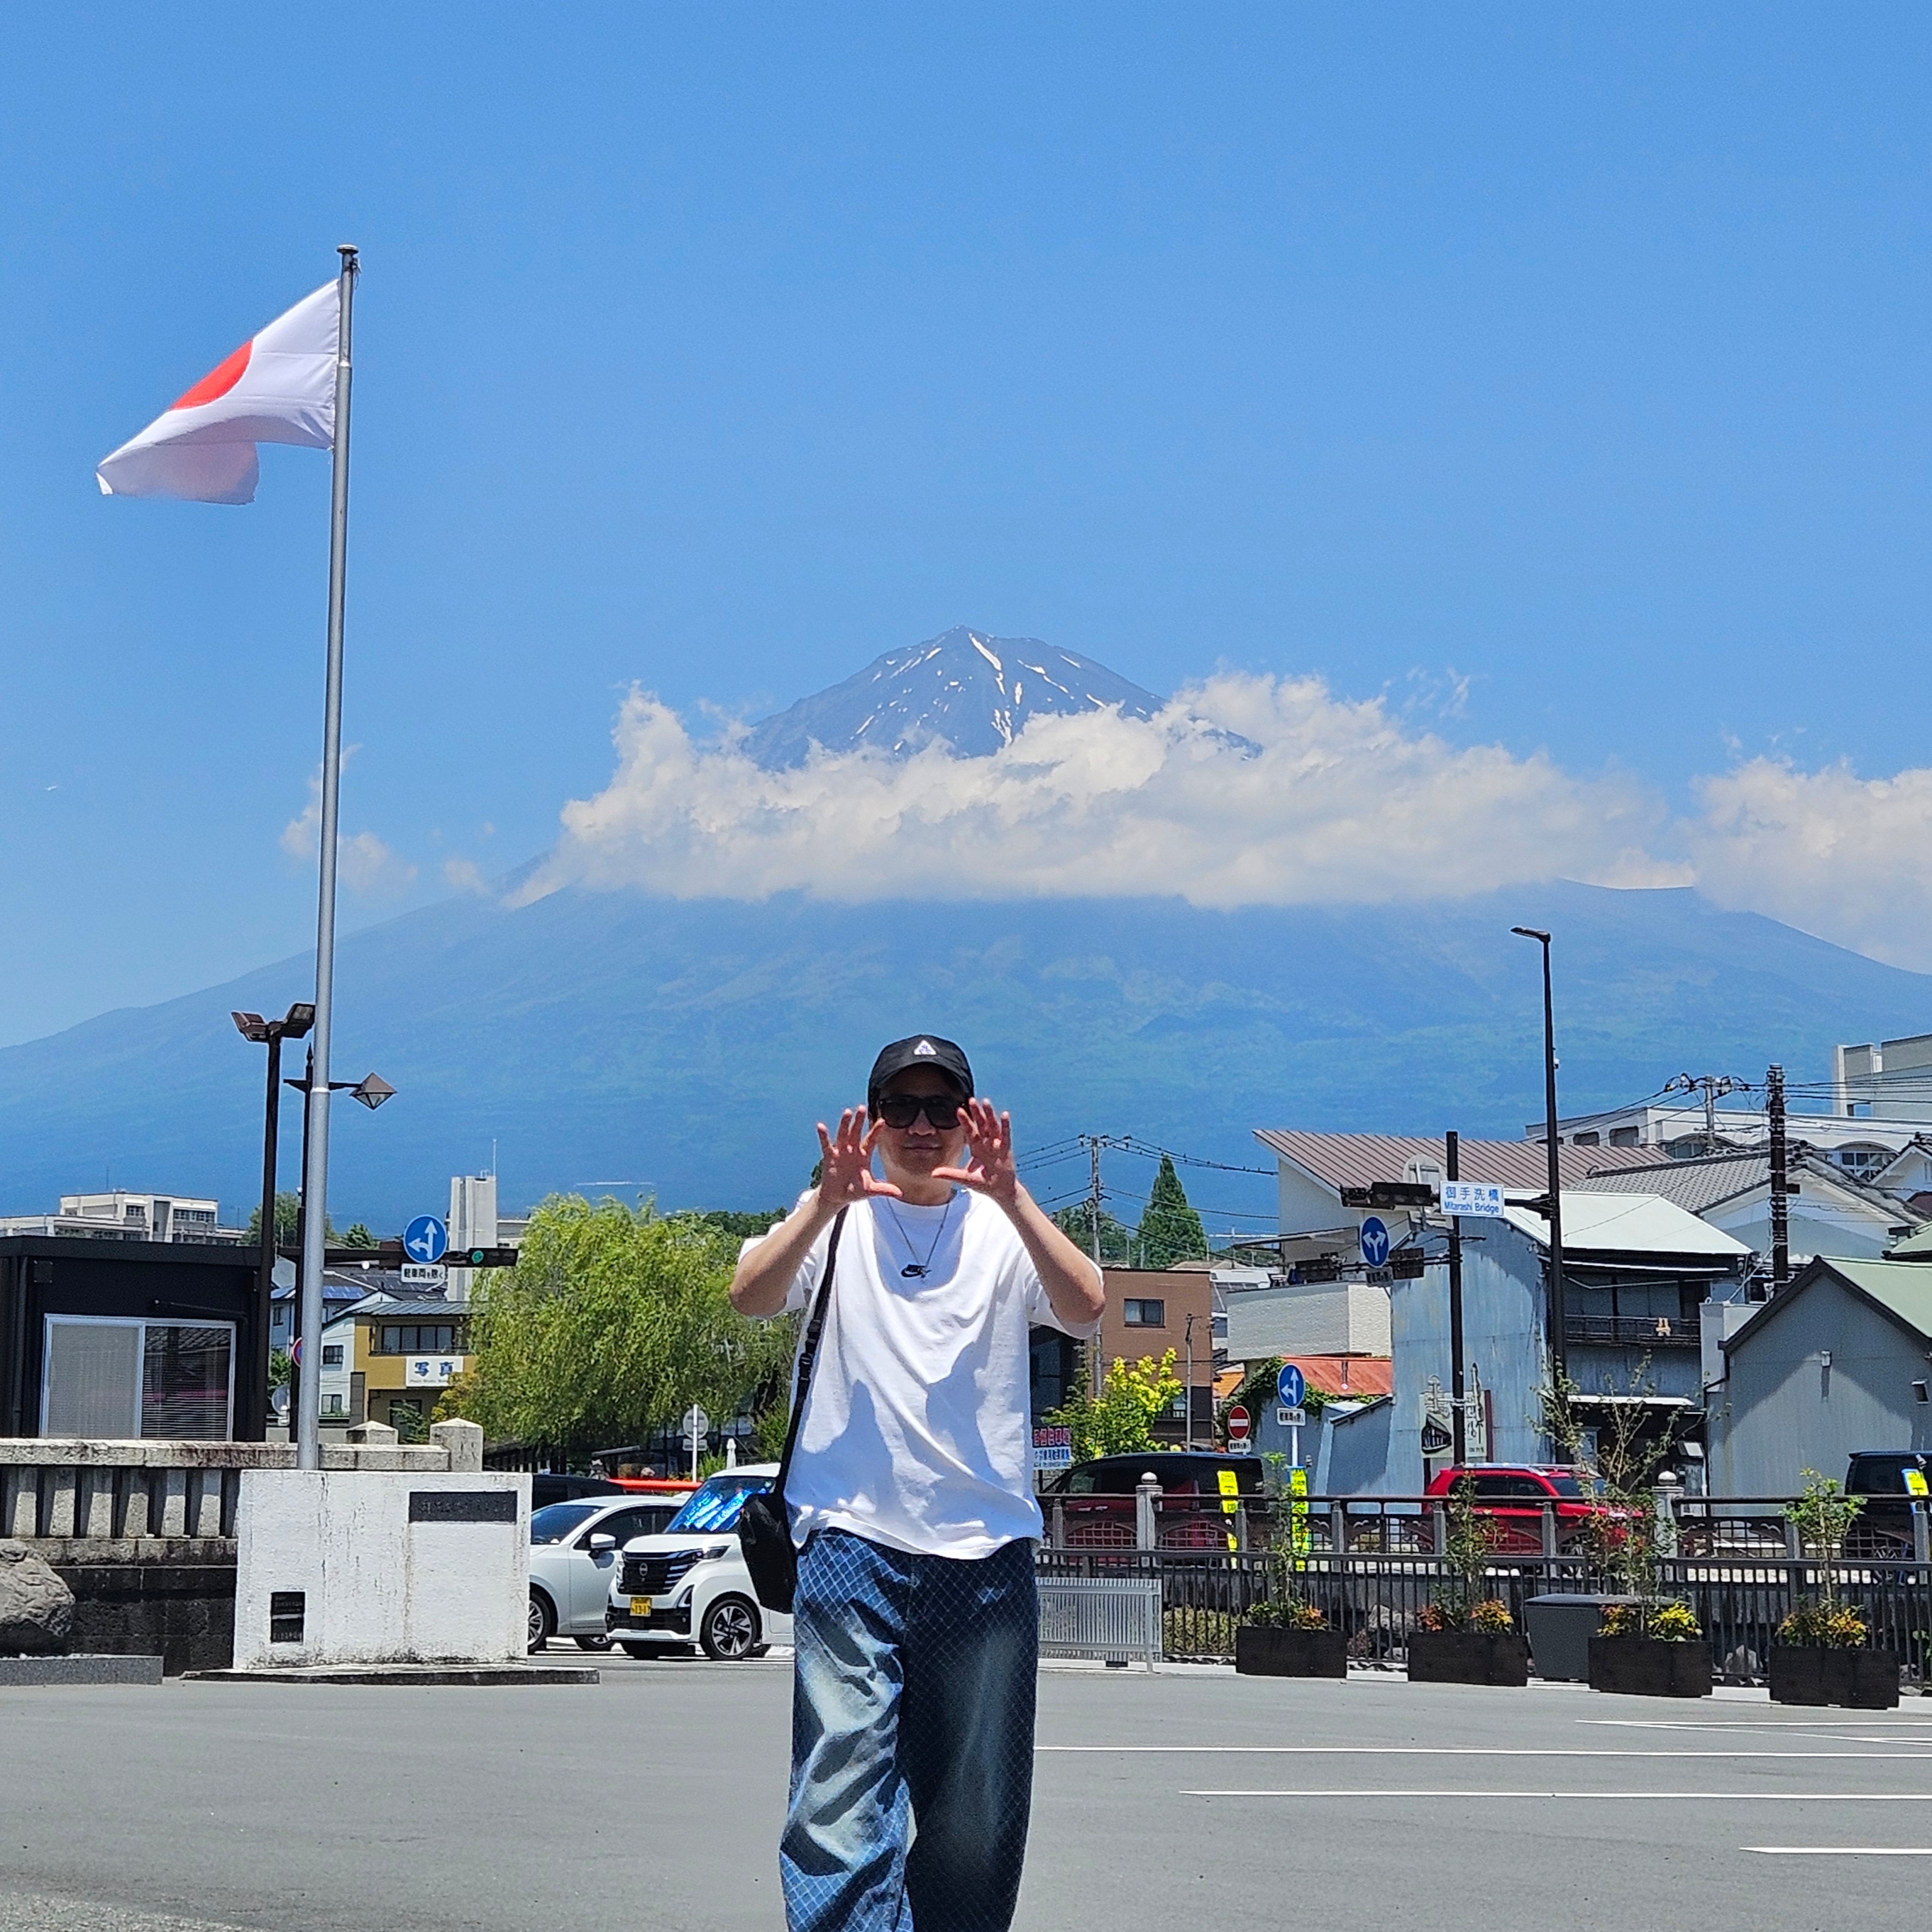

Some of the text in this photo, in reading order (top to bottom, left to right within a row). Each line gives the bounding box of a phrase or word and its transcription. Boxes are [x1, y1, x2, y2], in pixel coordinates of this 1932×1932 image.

[1445, 1186, 1498, 1202] 御手洗橋
[1445, 1201, 1499, 1215] Mitarashi Bridge
[404, 1268, 443, 1279] 軽車両を除く
[414, 1362, 454, 1376] 写真
